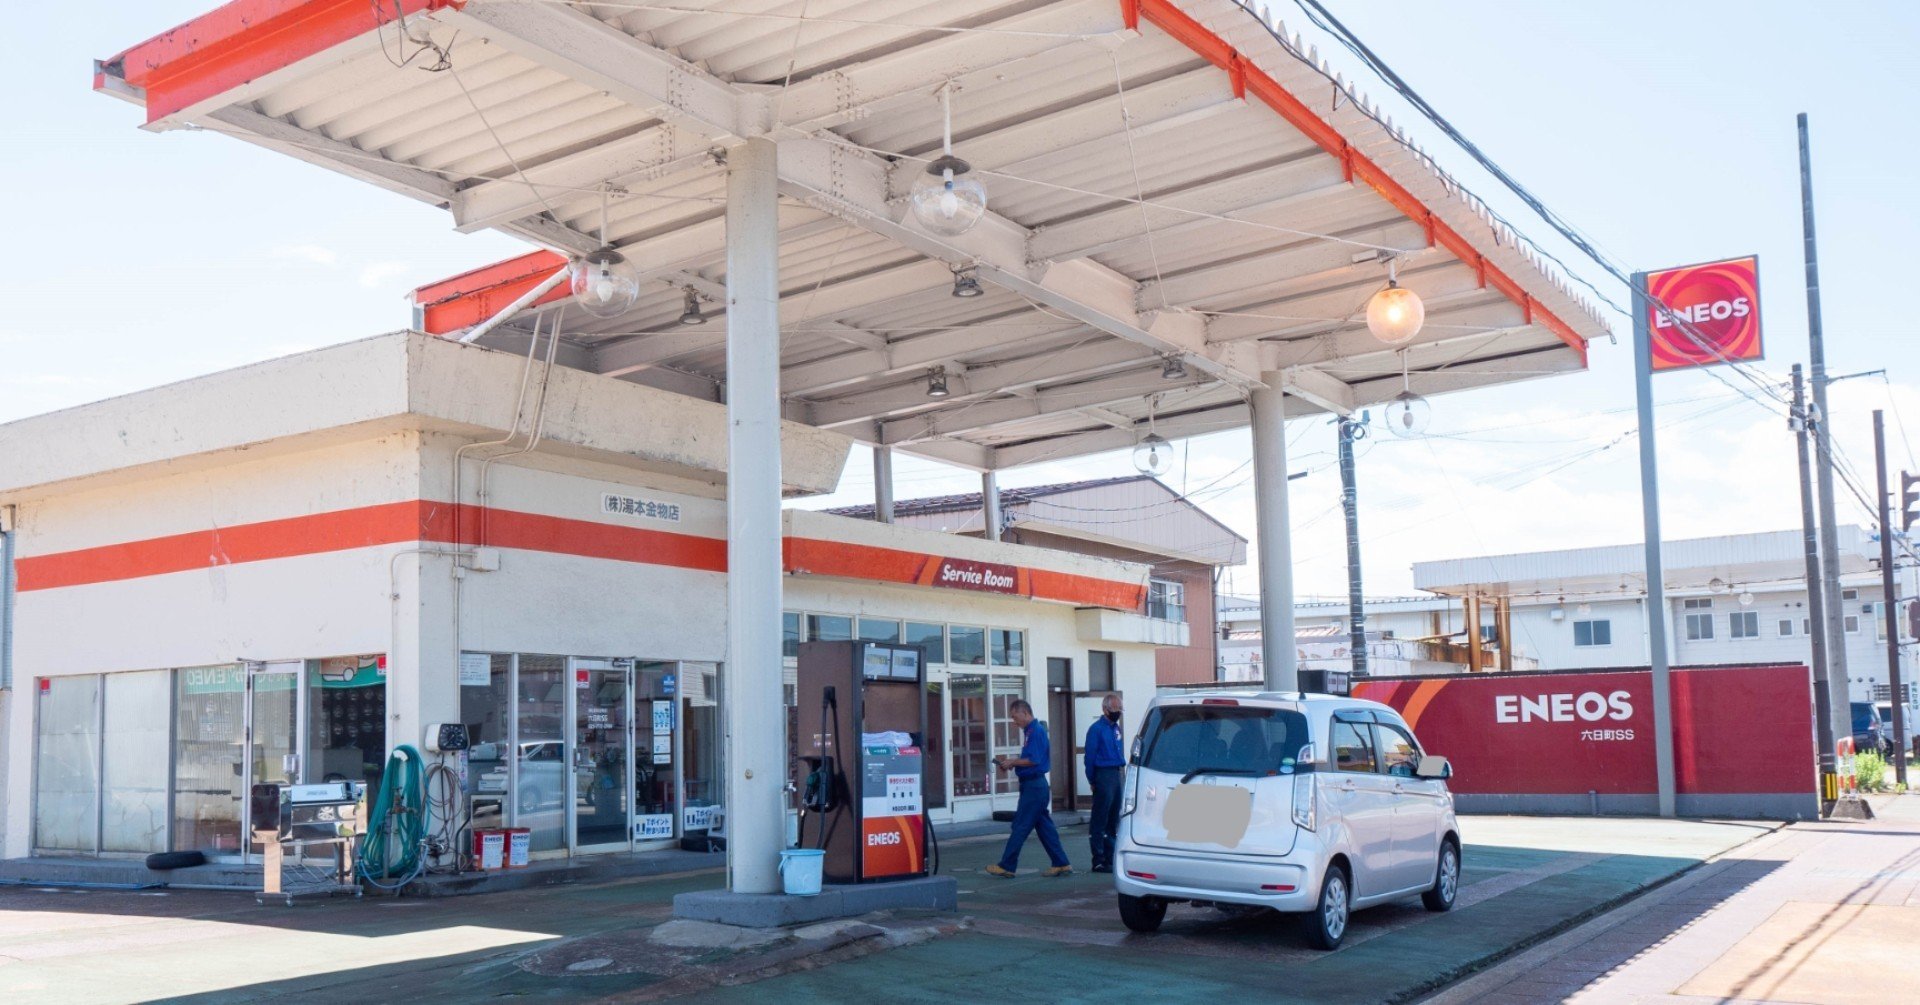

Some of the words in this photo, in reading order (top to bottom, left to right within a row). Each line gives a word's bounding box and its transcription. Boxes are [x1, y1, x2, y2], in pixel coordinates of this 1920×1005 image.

[1655, 297, 1750, 328] ENEOS
[604, 494, 680, 521] (株)湯本金物店
[942, 564, 982, 584] Service
[983, 569, 1014, 588] Room
[1495, 690, 1634, 723] ENEOS
[1581, 729, 1635, 741] 六日町SS
[867, 831, 901, 846] ENEOS
